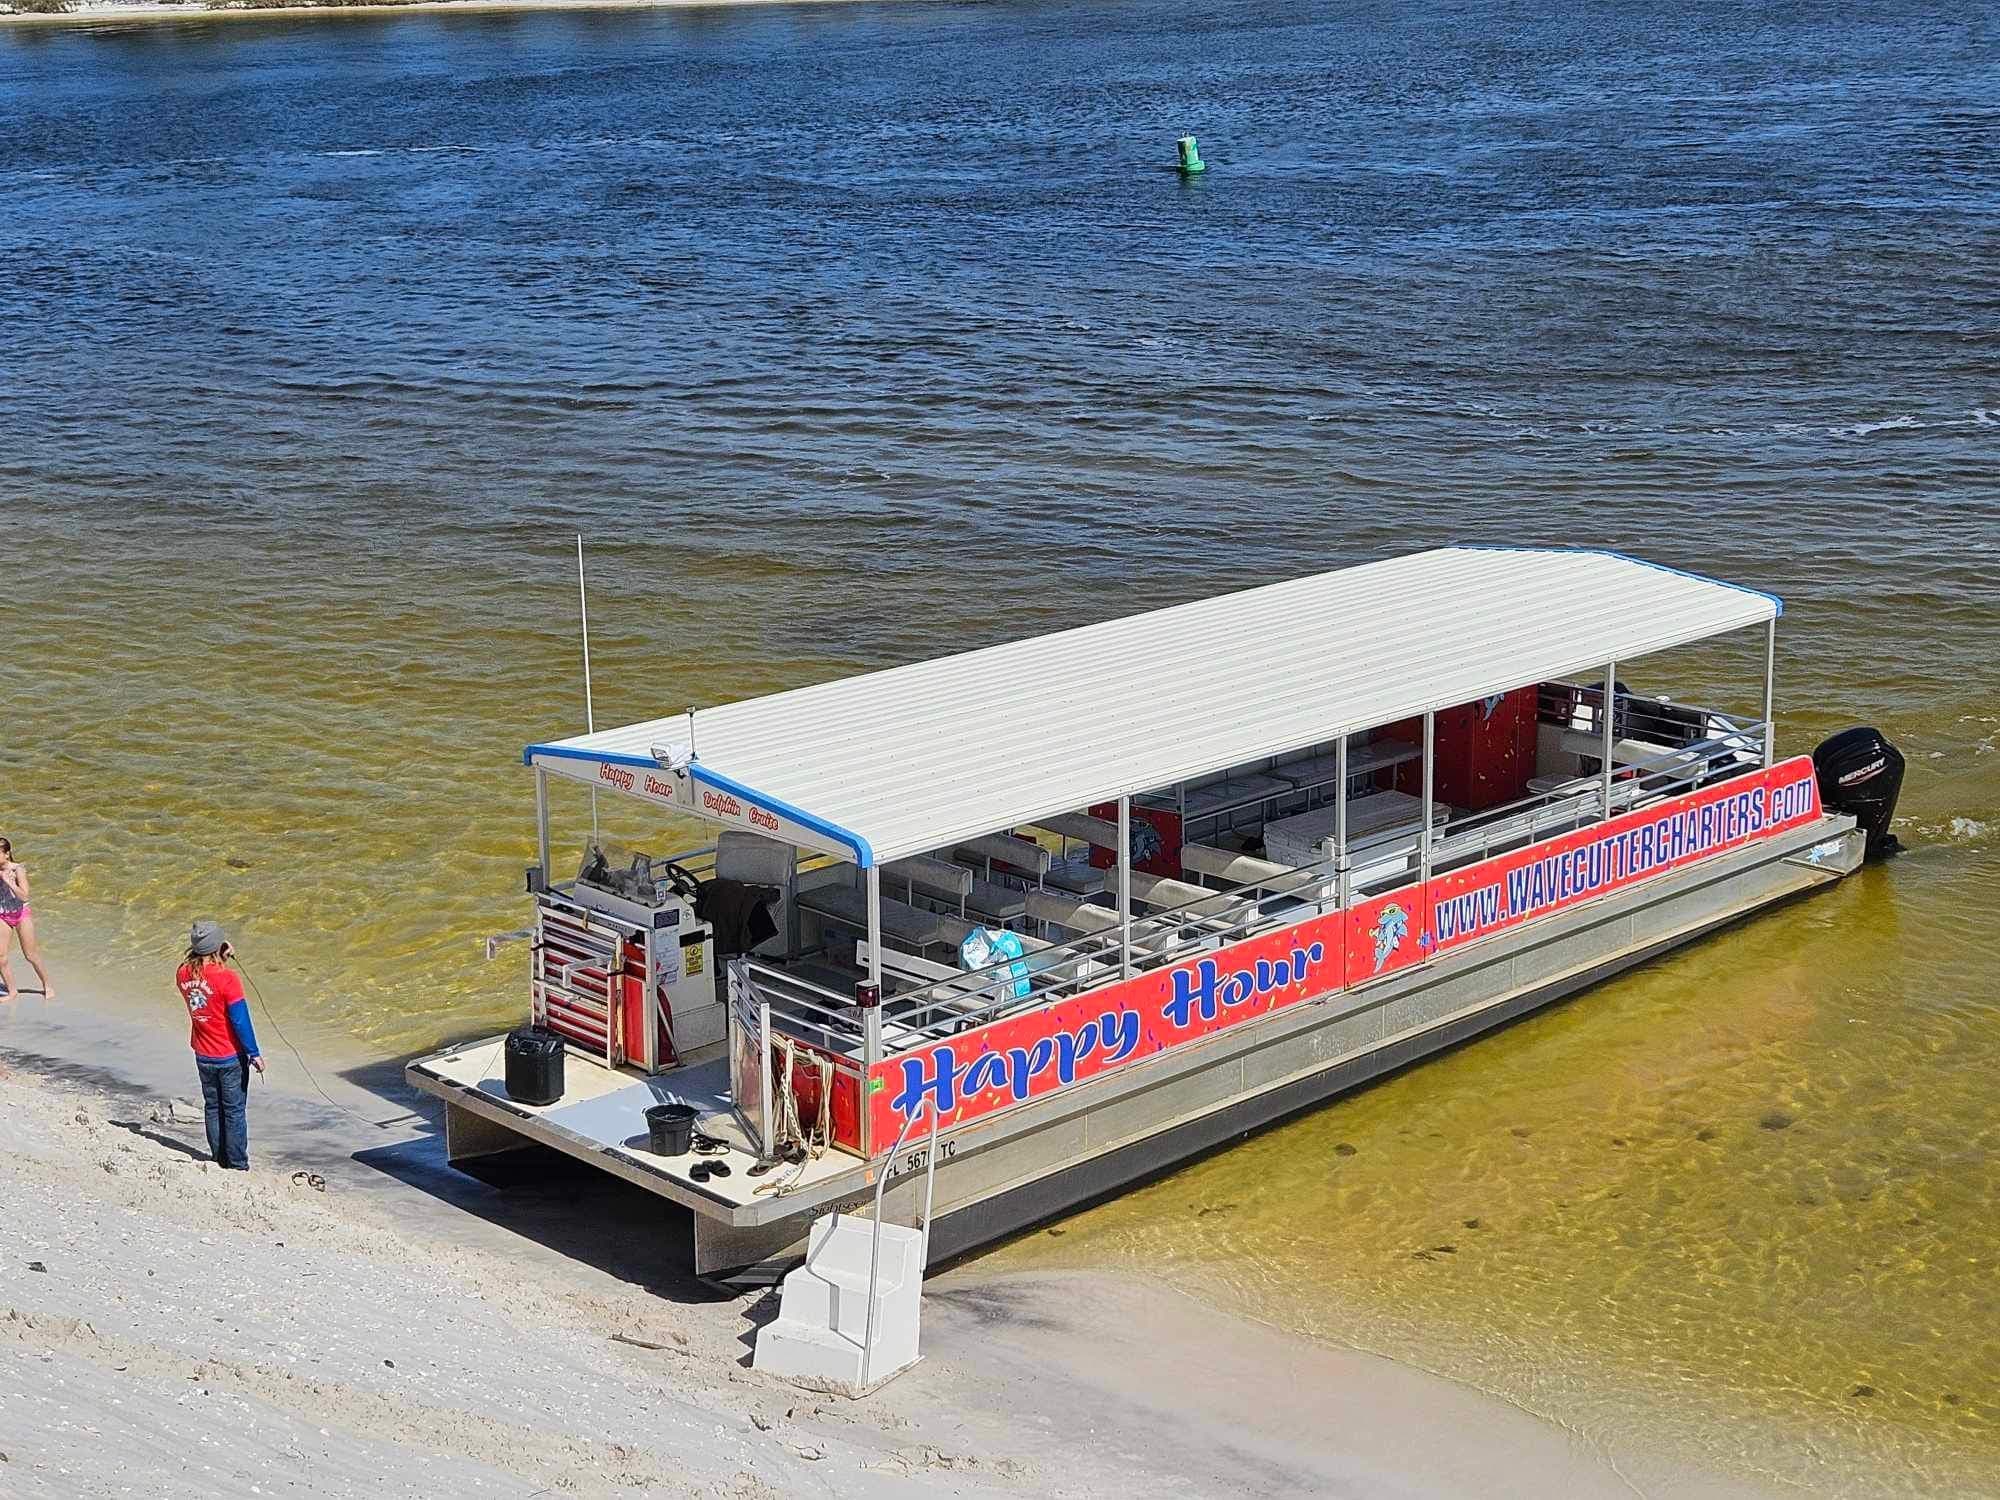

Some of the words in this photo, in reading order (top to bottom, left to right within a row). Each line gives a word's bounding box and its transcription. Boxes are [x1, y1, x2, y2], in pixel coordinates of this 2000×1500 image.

[600, 762, 634, 790] Happy
[644, 774, 672, 797] Hour
[1838, 757, 1885, 784] MERCURY
[703, 791, 740, 816] Dolphin
[749, 807, 779, 830] Cruise
[891, 1009, 1141, 1121] Happy
[1162, 941, 1325, 1028] Hour
[907, 1150, 931, 1171] 567
[941, 1140, 956, 1159] TC
